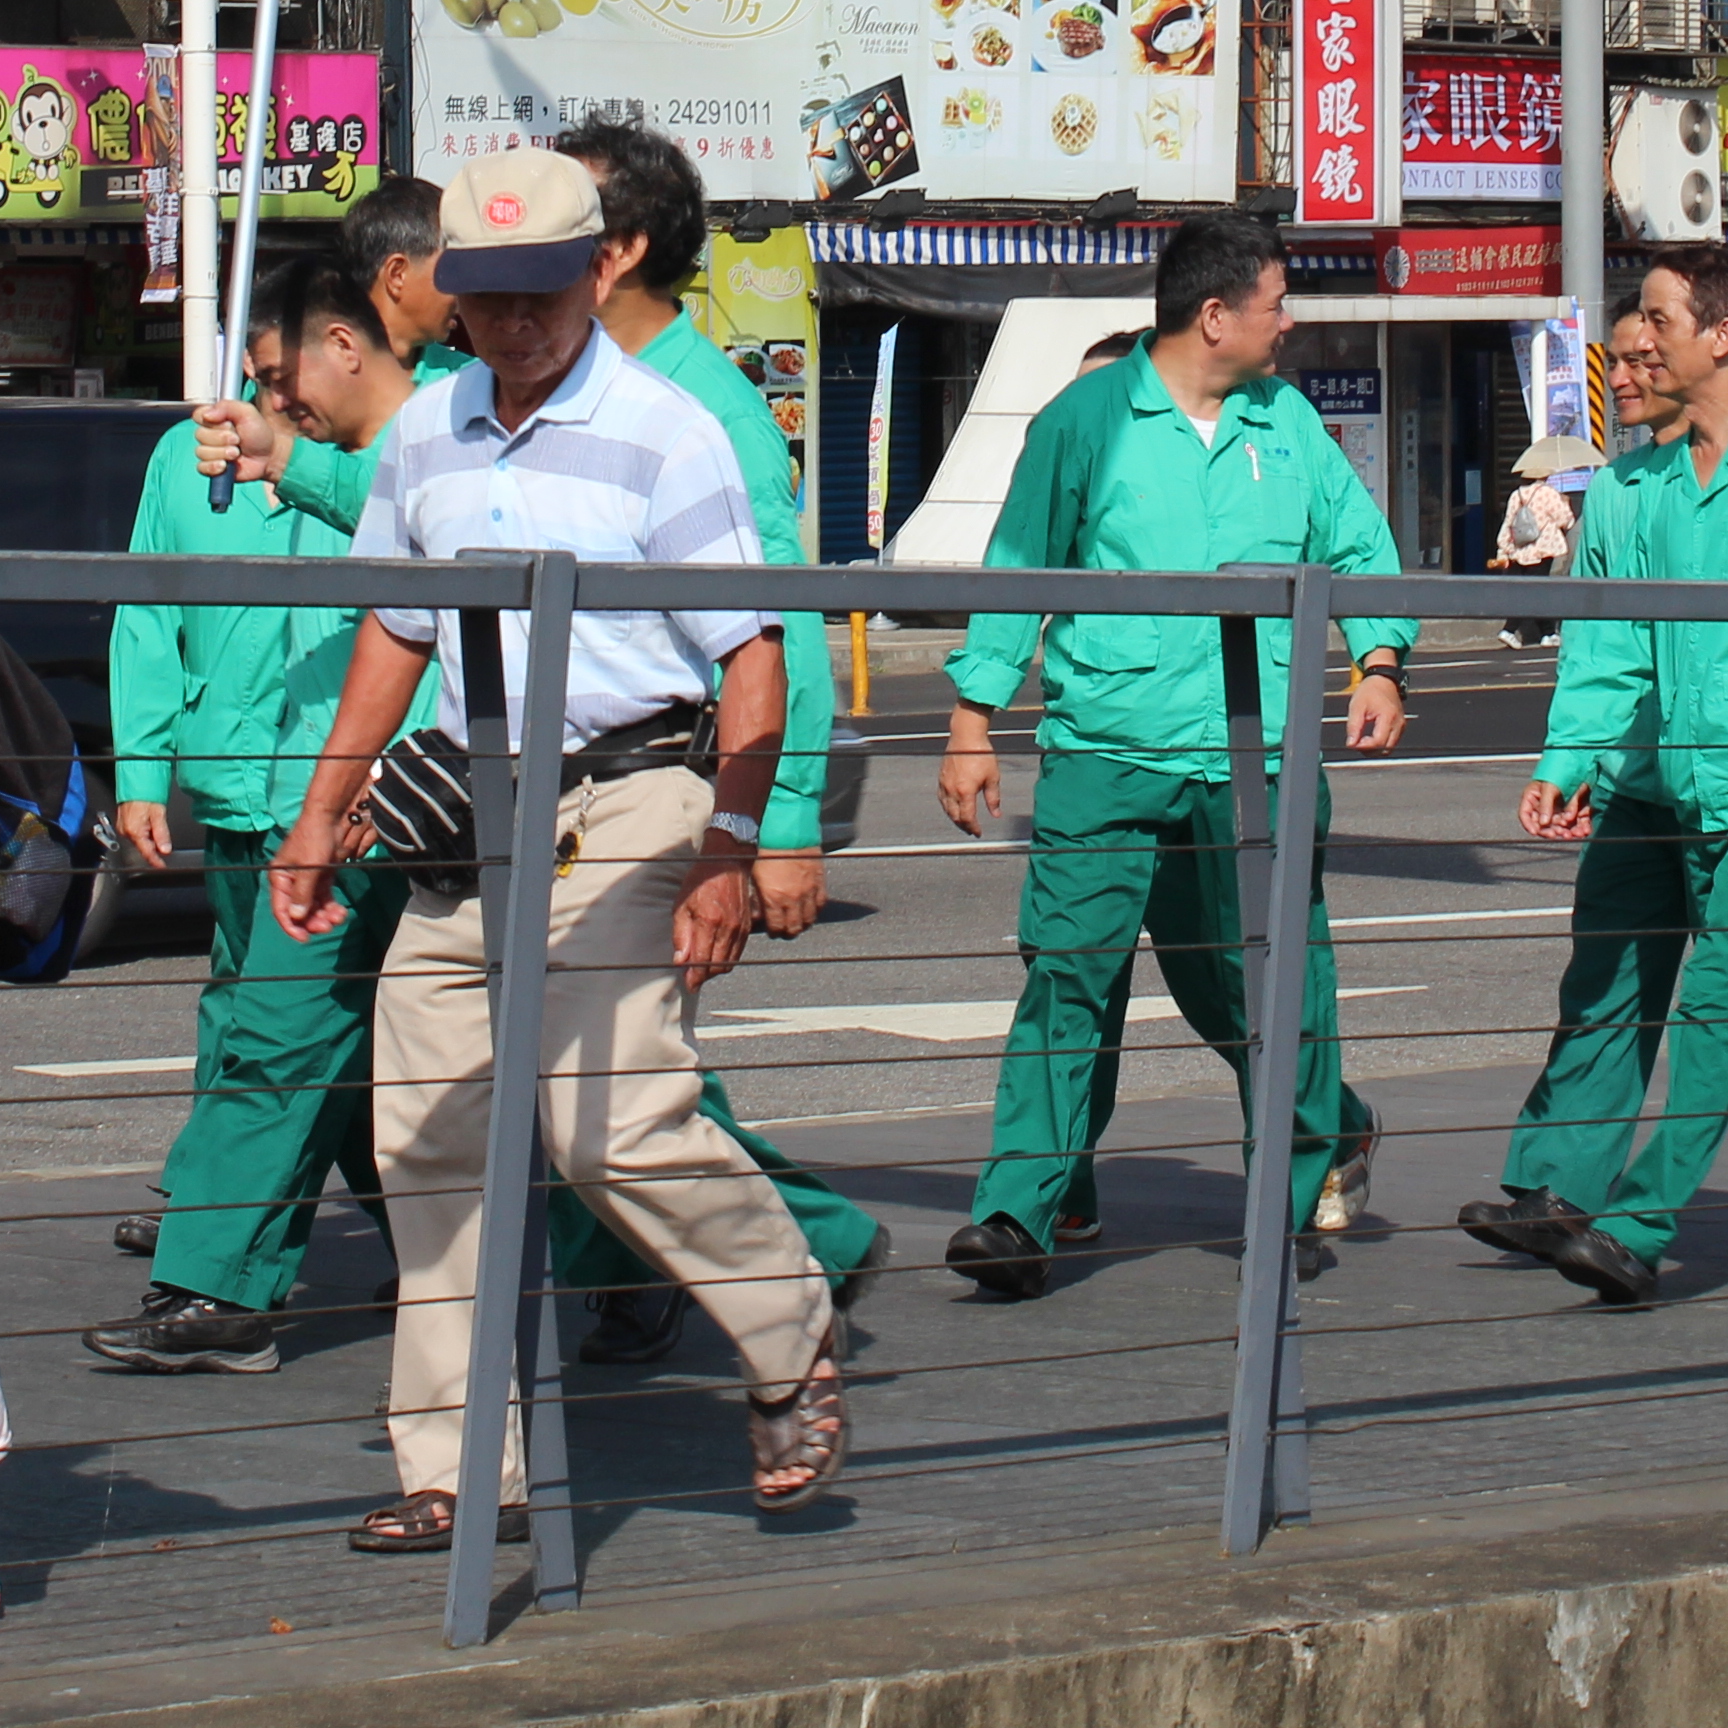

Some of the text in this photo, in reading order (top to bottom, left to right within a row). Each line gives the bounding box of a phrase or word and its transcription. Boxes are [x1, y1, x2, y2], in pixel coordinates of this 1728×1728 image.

[838, 4, 920, 36] Macaron
[1402, 70, 1562, 154] 家眼鏡
[287, 119, 365, 154] 基隆店
[697, 138, 709, 158] 9
[717, 135, 775, 160] 折優惠
[217, 163, 314, 192] OKEY
[1402, 169, 1465, 189] NTACT
[1475, 170, 1538, 189] LENSES
[870, 422, 883, 439] 30
[868, 515, 882, 531] 50
